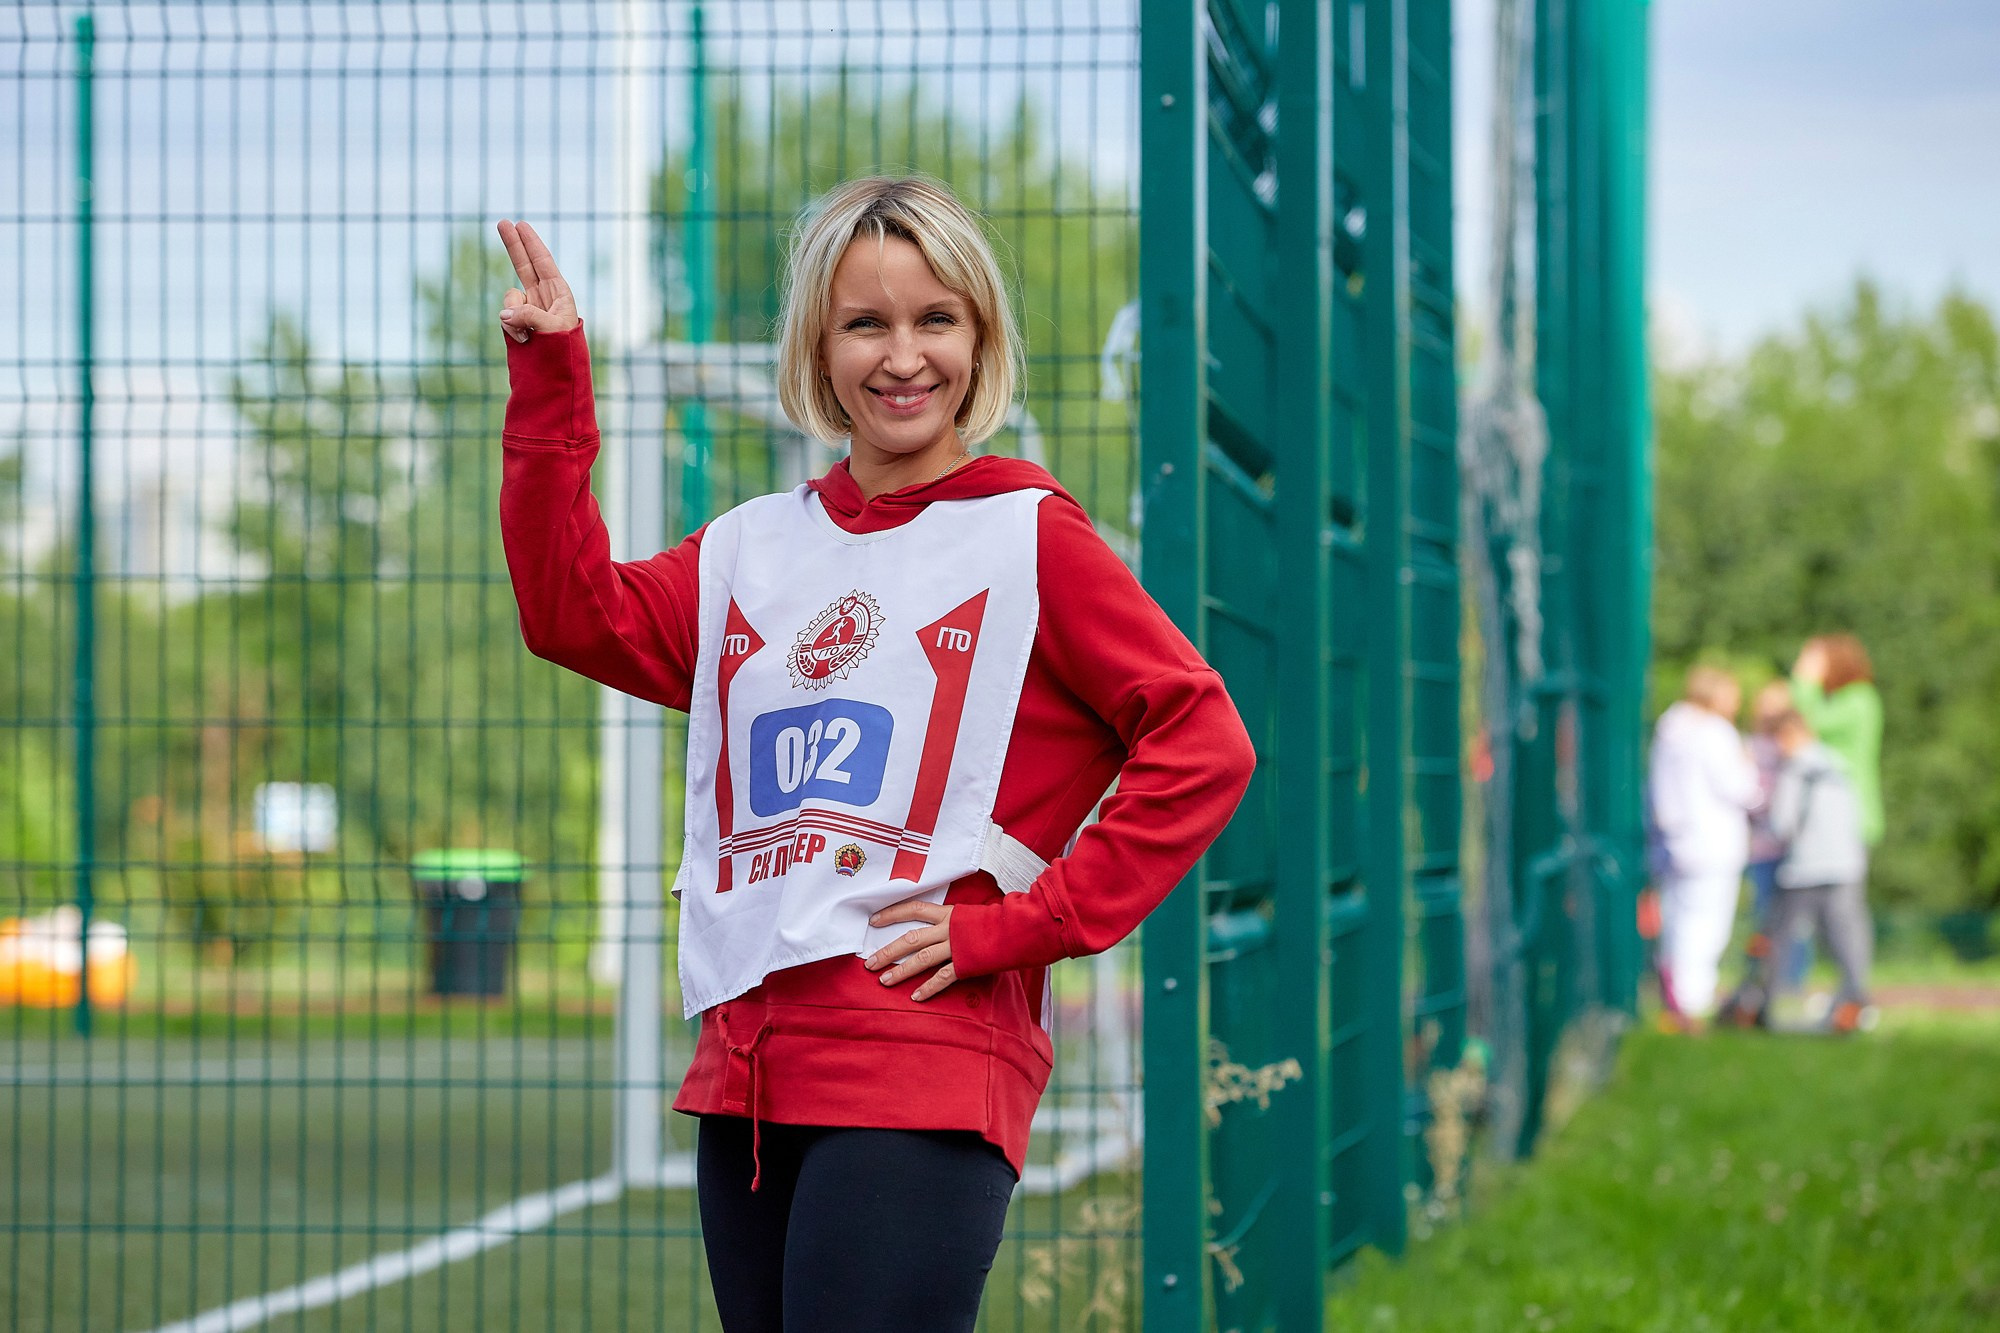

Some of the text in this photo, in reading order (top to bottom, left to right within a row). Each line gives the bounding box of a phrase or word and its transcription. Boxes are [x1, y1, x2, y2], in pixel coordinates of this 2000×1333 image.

[721, 633, 750, 657] ГТО
[936, 626, 972, 652] ГТО
[817, 646, 840, 659] ГТО
[776, 717, 861, 793] 032
[748, 833, 826, 884] СК ЛЕР
